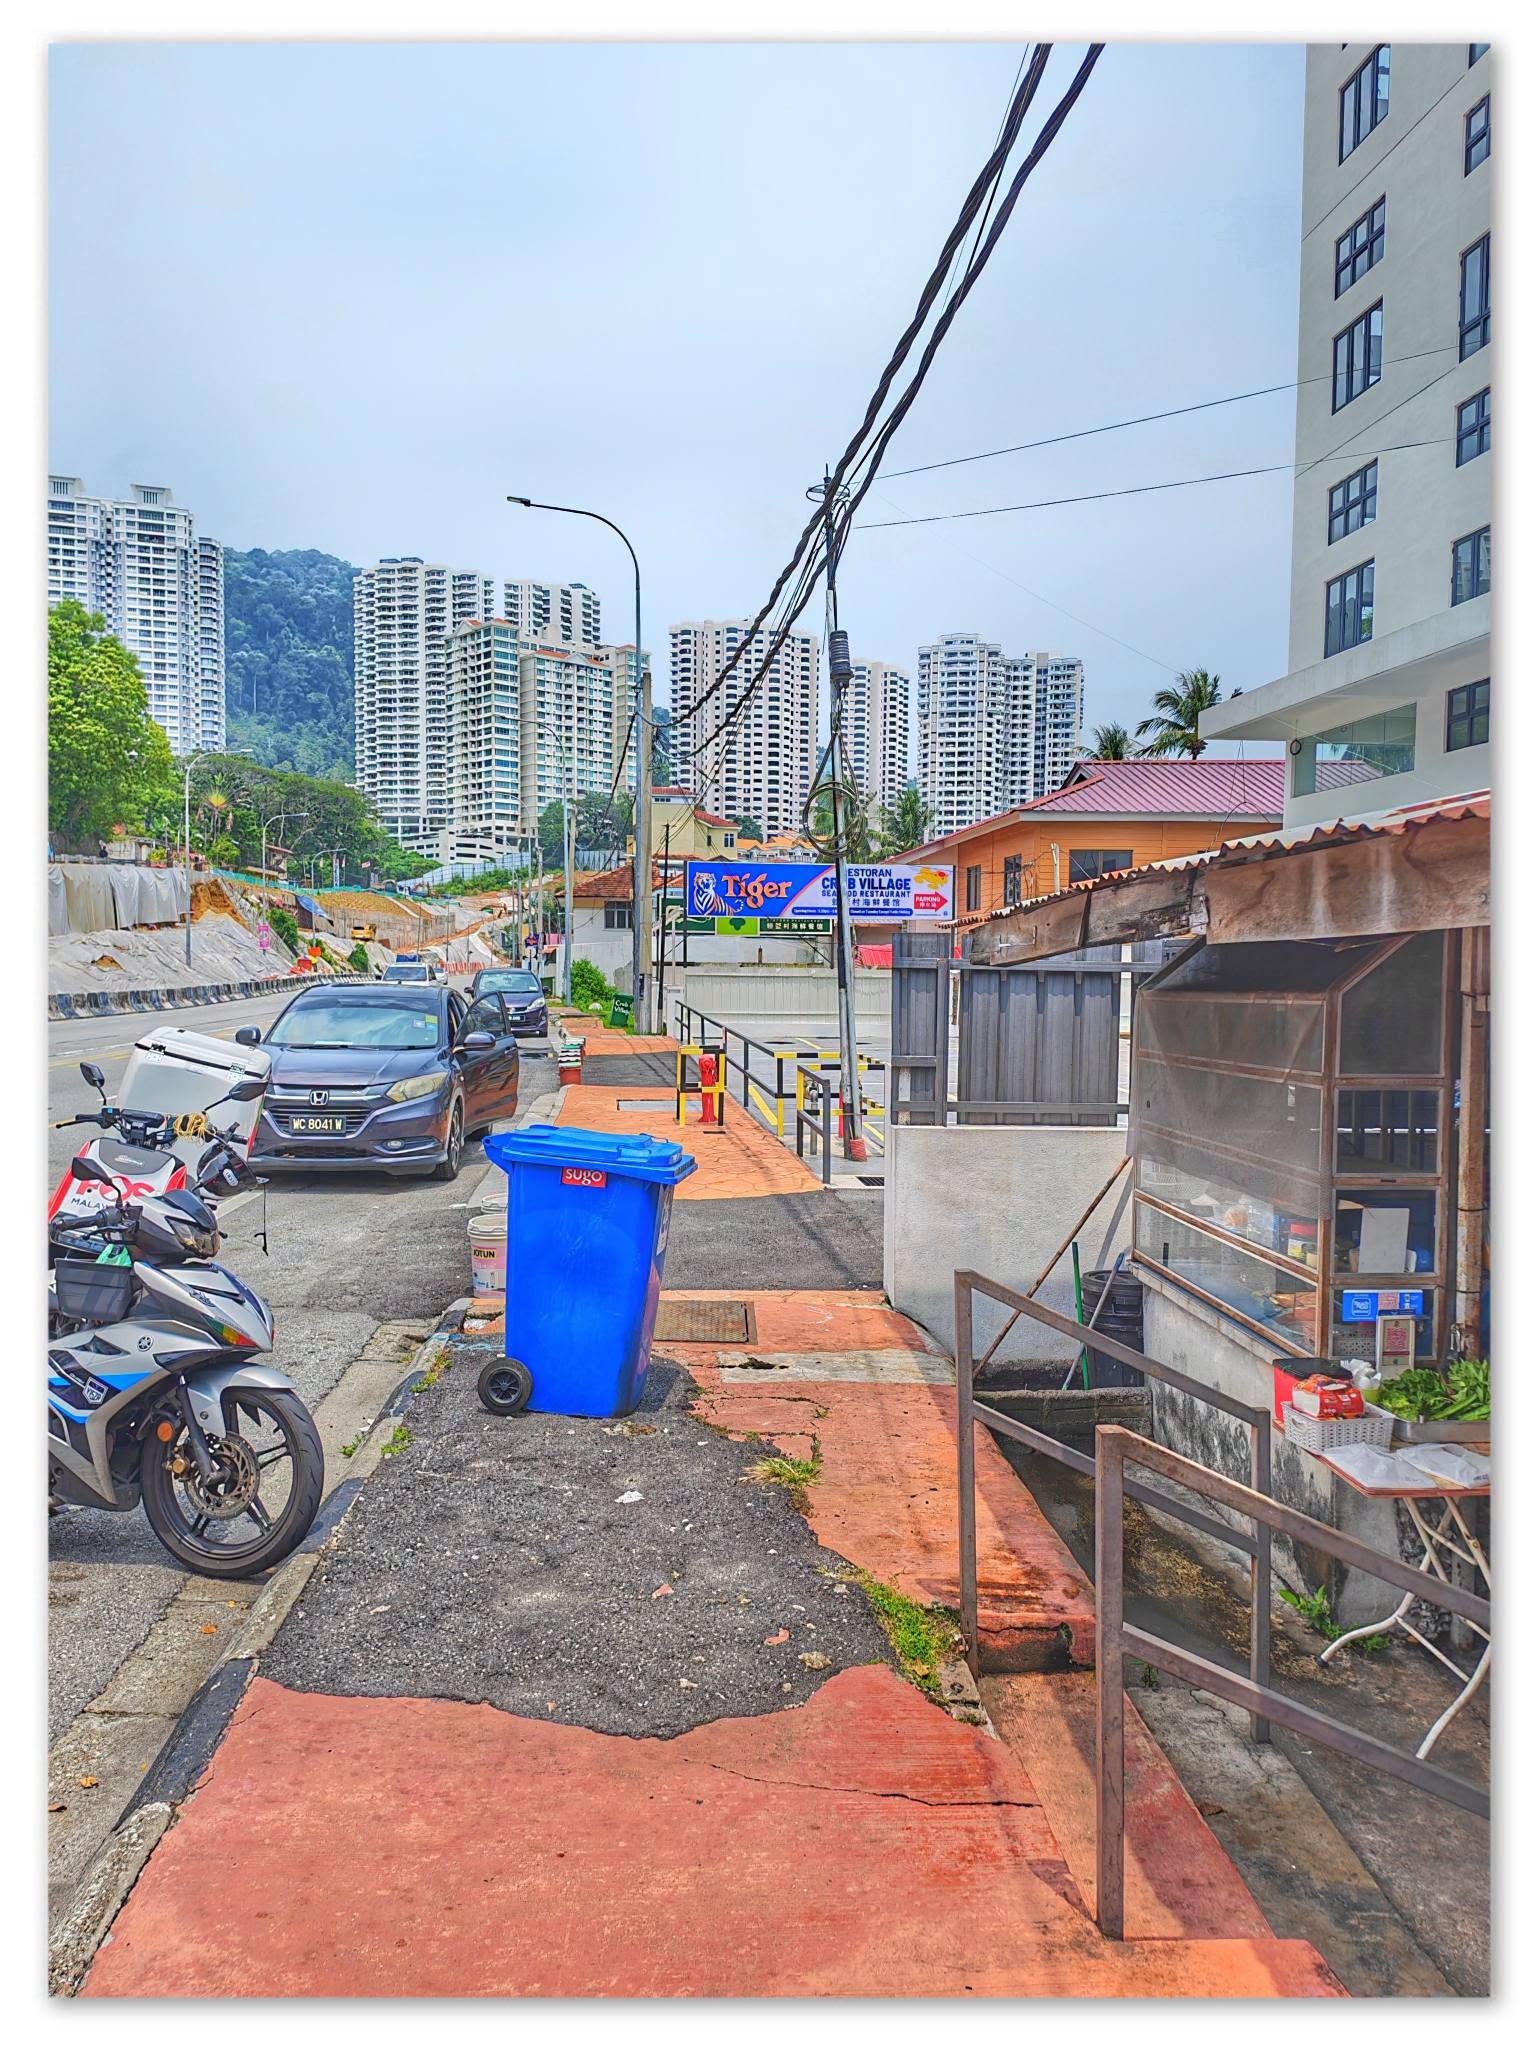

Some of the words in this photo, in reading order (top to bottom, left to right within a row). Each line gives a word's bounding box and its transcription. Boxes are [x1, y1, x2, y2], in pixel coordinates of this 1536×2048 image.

[847, 868, 892, 878] ESTORAN
[821, 877, 856, 890] CRB
[859, 877, 911, 890] VILLAGE
[721, 873, 792, 909] Tiger
[821, 890, 858, 898] SEAOD
[860, 890, 911, 898] RESTAURANT
[293, 1118, 306, 1130] WC
[308, 1118, 333, 1130] 8041
[335, 1118, 343, 1130] W
